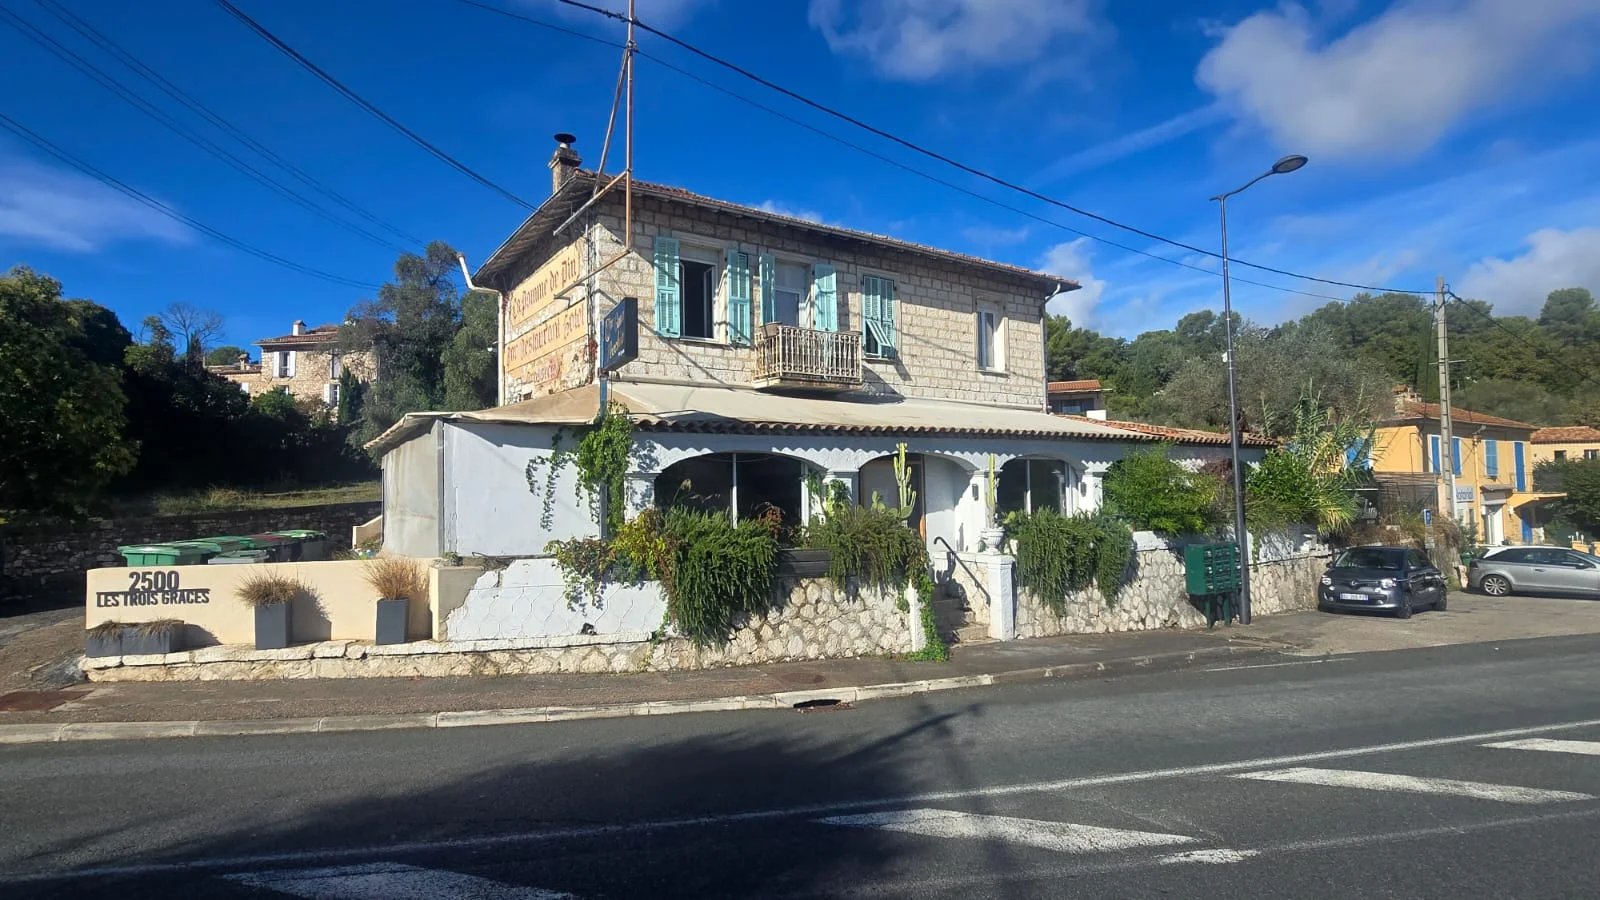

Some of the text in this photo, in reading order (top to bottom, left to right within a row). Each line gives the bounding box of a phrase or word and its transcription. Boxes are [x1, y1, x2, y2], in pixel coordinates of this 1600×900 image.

[549, 269, 559, 290] de
[562, 258, 577, 285] Pin
[129, 570, 180, 592] 2500
[96, 590, 210, 608] LES TROIS GRACES
